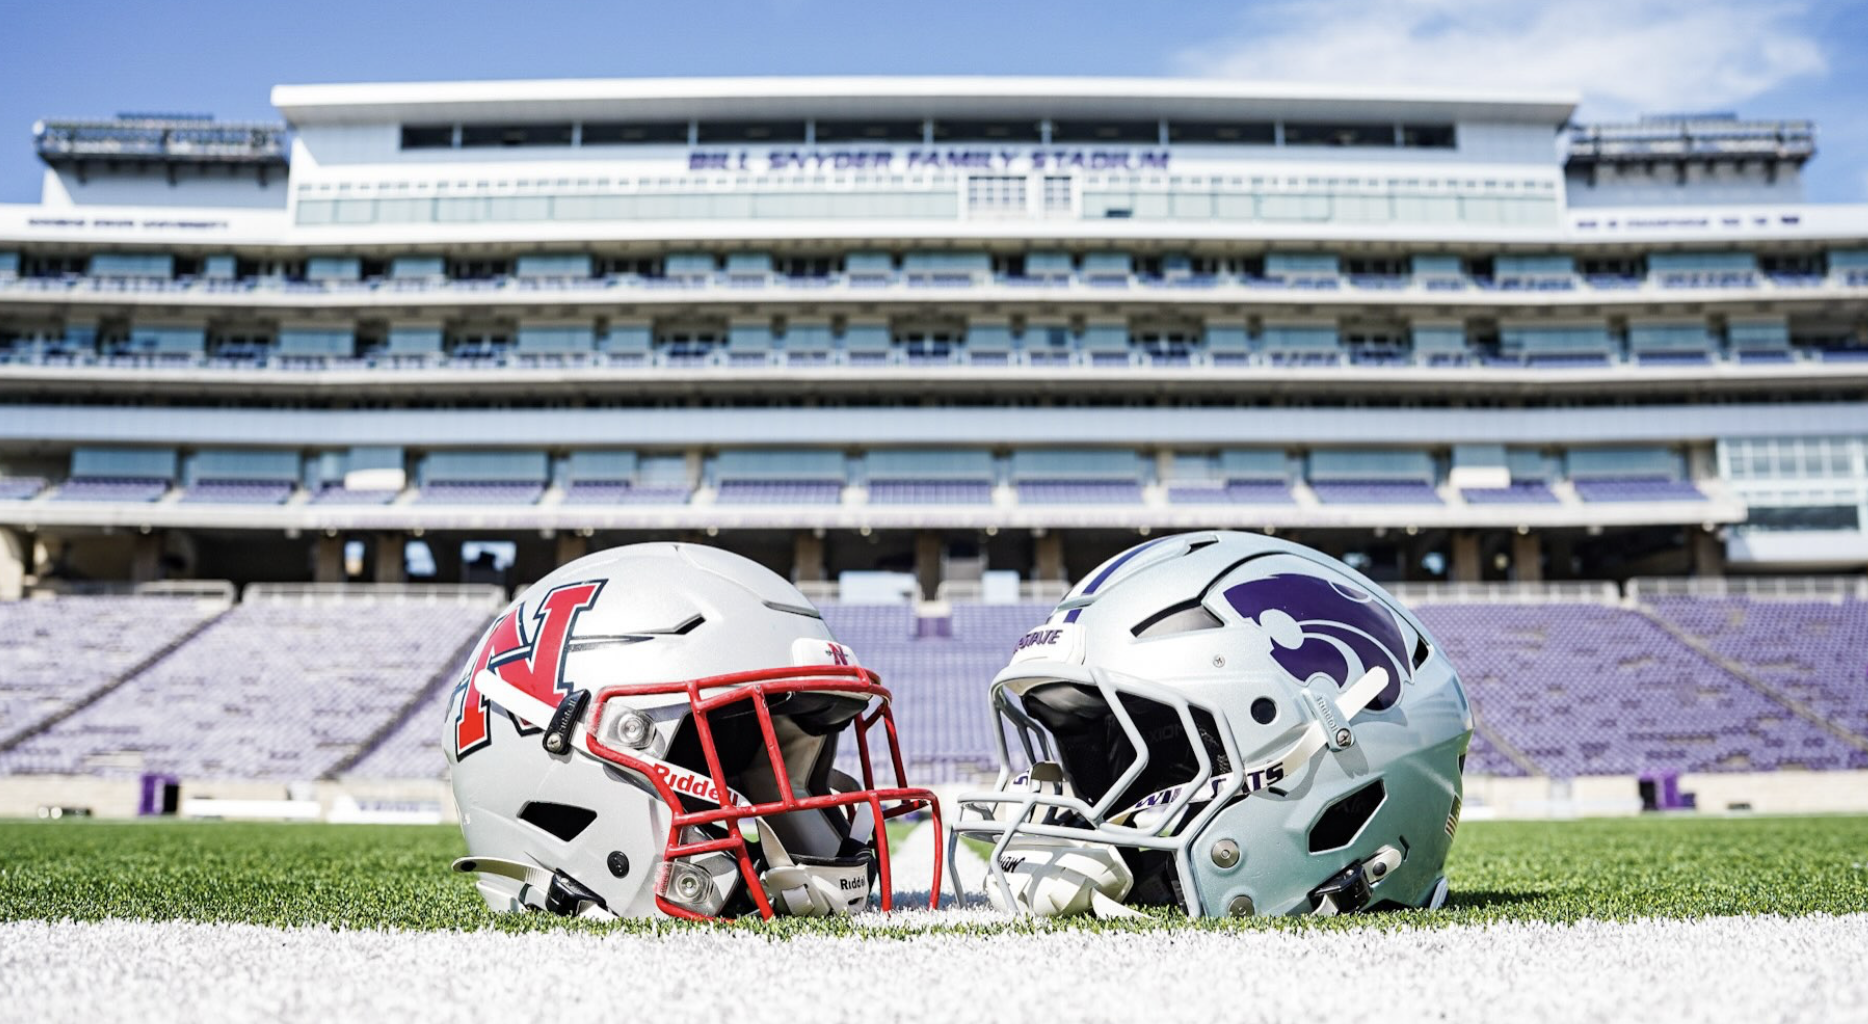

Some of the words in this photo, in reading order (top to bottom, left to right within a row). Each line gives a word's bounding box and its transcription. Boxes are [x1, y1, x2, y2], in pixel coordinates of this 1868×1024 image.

[688, 150, 758, 171] BILL
[768, 150, 893, 171] SNYDER
[907, 150, 1022, 171] FAMILY
[1032, 150, 1171, 171] STADIUM
[455, 579, 609, 762] N
